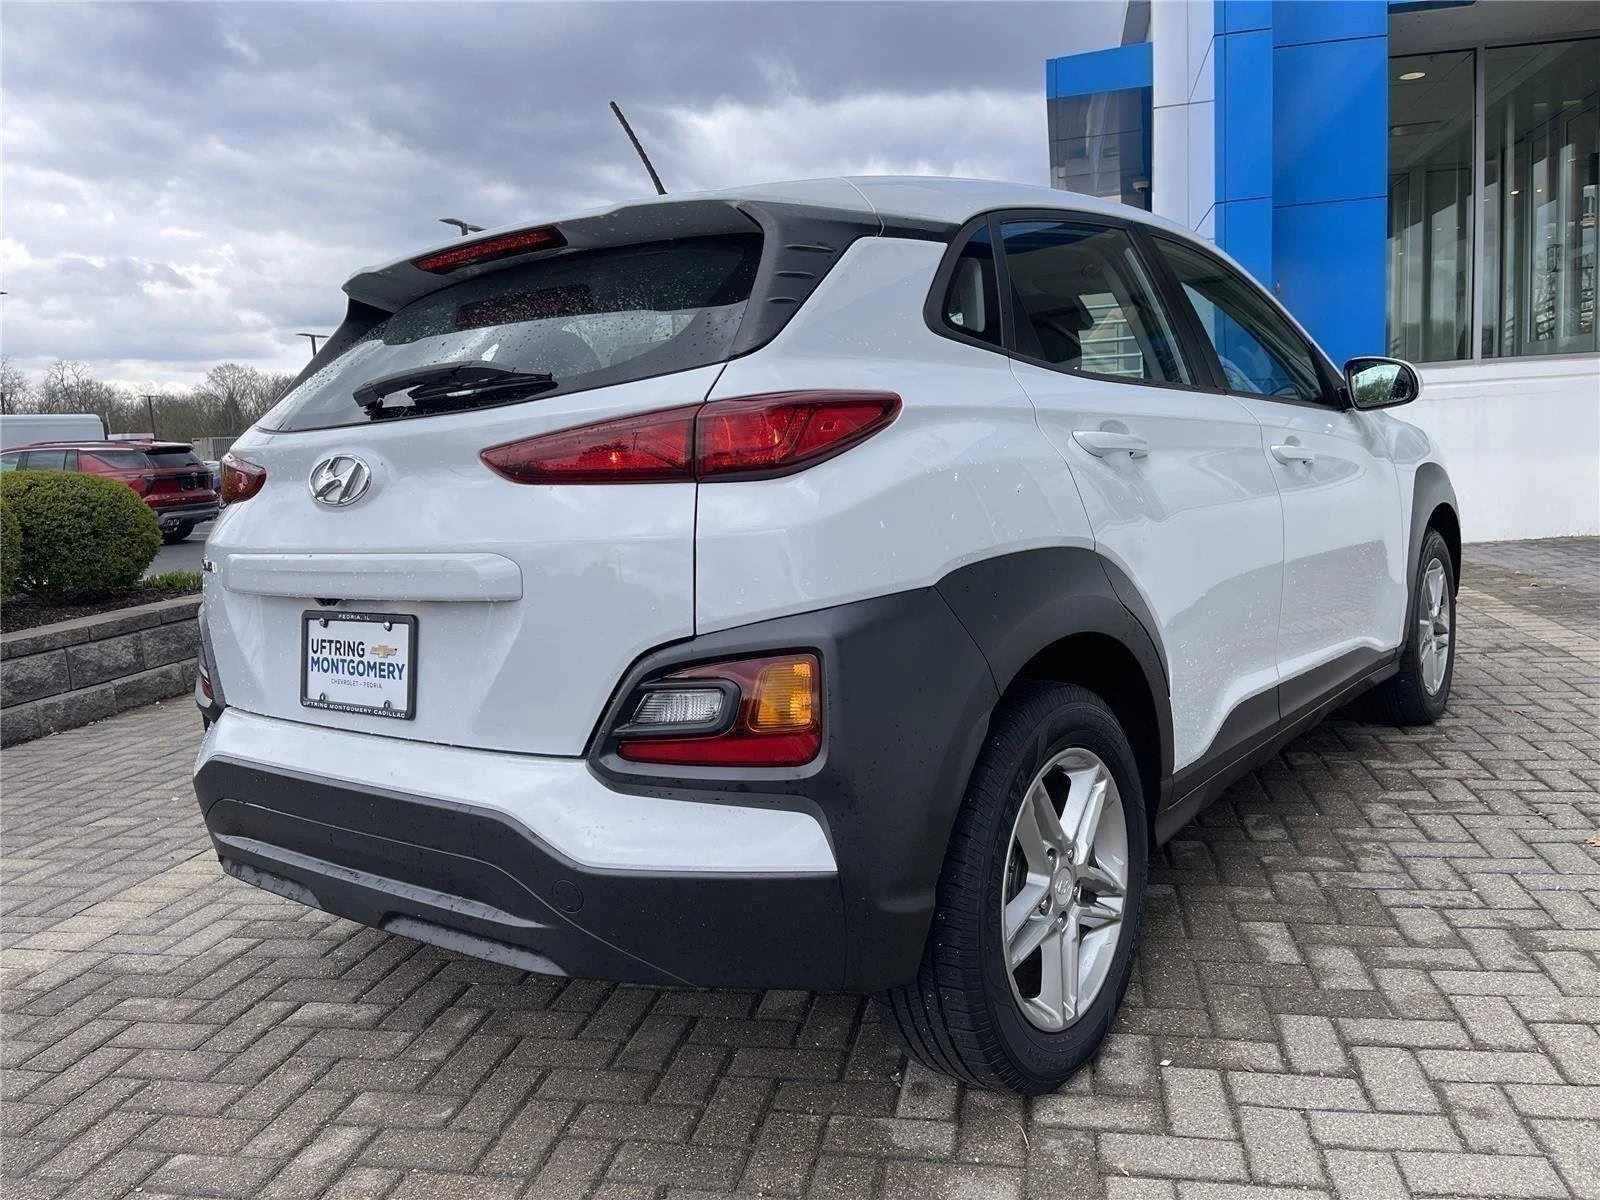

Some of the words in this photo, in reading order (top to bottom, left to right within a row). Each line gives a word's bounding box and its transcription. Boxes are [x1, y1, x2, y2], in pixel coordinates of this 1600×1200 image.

[311, 638, 365, 658] UFTRING
[310, 657, 405, 680] MONTGOMERY
[331, 678, 359, 687] CHEVROLET
[363, 681, 383, 689] PEORIA
[329, 704, 372, 714] MONTGOMERY
[373, 709, 406, 719] CADILLAC
